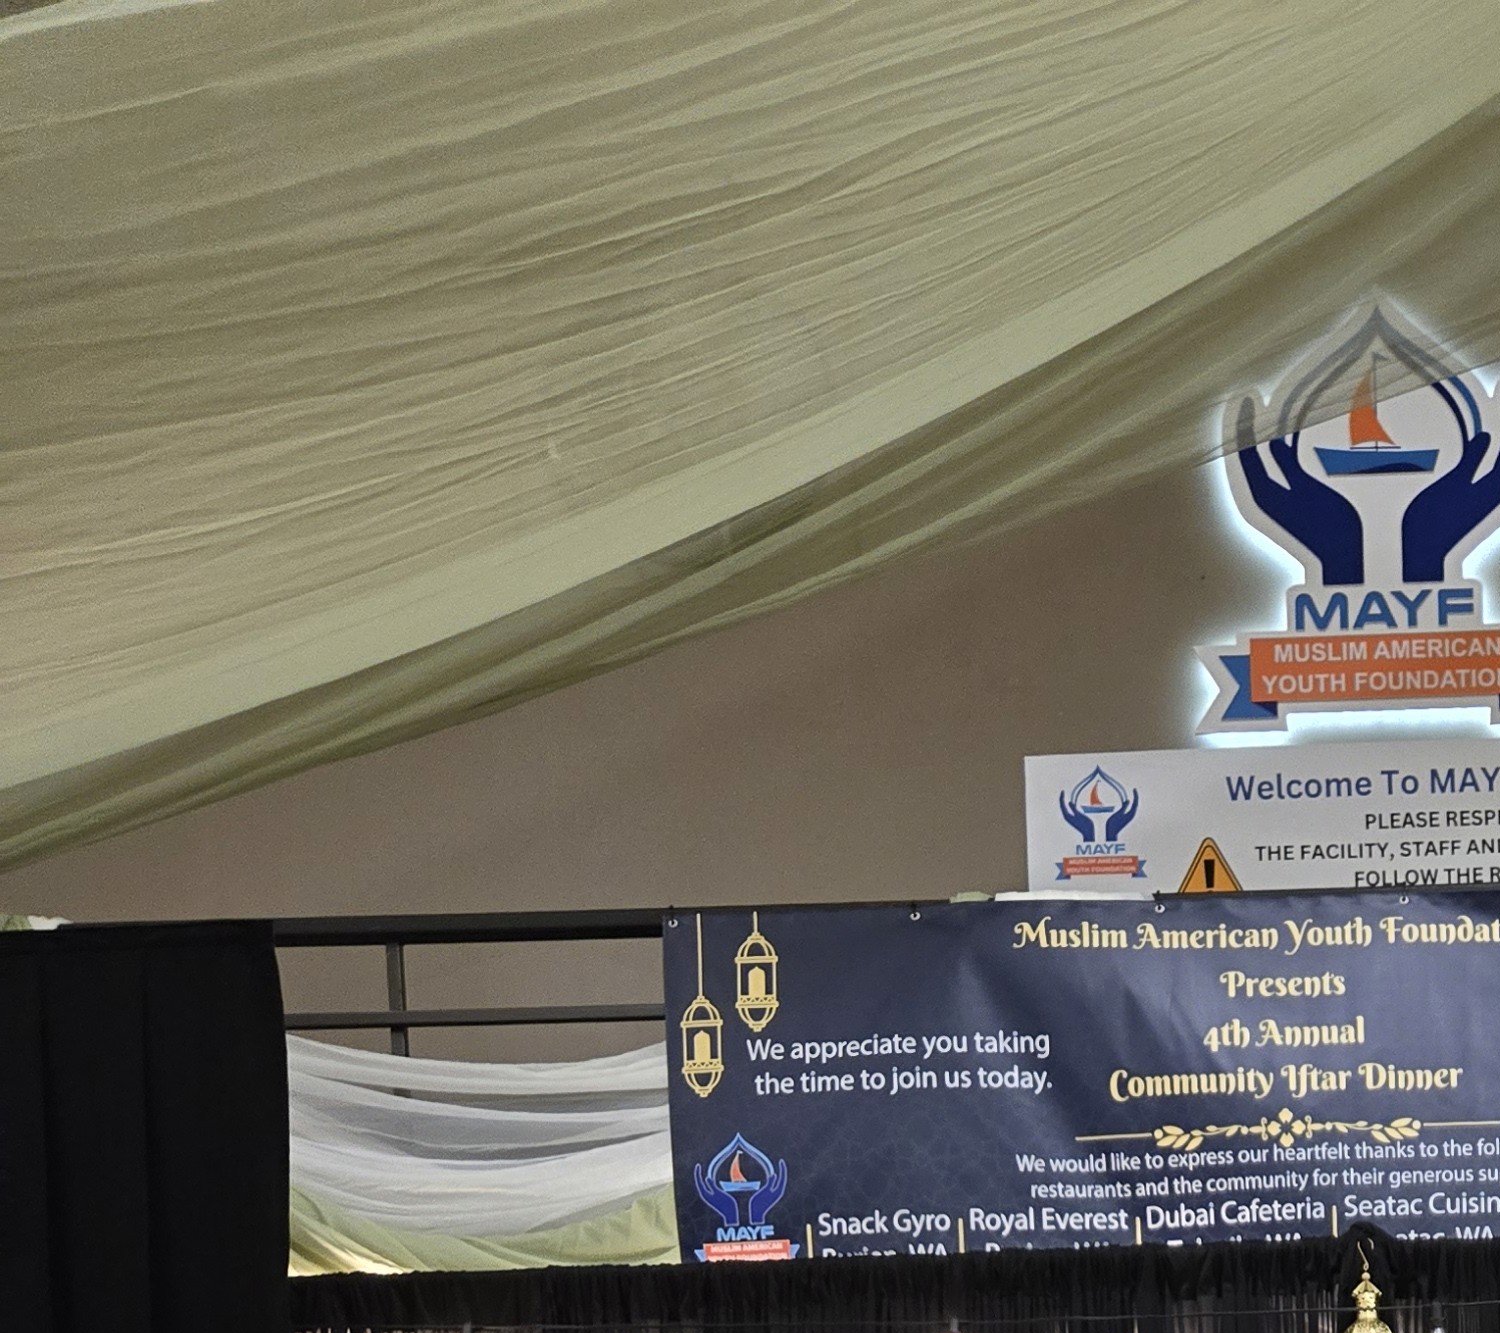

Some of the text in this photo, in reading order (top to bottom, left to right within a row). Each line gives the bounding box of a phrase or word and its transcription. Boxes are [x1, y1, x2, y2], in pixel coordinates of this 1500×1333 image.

[1295, 588, 1473, 631] MAYF
[1274, 637, 1500, 664] MUSLIM AMERICAN
[1262, 674, 1346, 695] YOUTH
[1226, 773, 1372, 800] Welcome
[1381, 770, 1418, 797] To
[1365, 811, 1440, 830] PLEASE
[1076, 843, 1126, 856] MAYF
[1255, 845, 1294, 861] THE
[1301, 841, 1395, 861] FACILITY,
[1400, 838, 1460, 857] STAFF
[1355, 868, 1438, 888] FOLLOW
[1444, 866, 1483, 884] THE
[1012, 916, 1128, 949] Muslim
[1132, 922, 1279, 950] American
[1284, 916, 1372, 955] Youth
[1219, 970, 1346, 998] Presents
[746, 1030, 1050, 1064] We appreciate you taking
[1203, 1016, 1365, 1052] 4th Annual
[754, 1063, 1053, 1096] the time to join us today.
[1109, 1061, 1464, 1102] Community Iftar Dinner
[1015, 1154, 1045, 1172] We
[1049, 1152, 1106, 1173] would
[1110, 1152, 1140, 1171] like
[1144, 1152, 1164, 1169] to
[1167, 1146, 1234, 1170] express
[1237, 1148, 1269, 1163] our
[1273, 1142, 1350, 1162] heartfelt
[1354, 1140, 1415, 1159] thanks
[1418, 1141, 1438, 1158] to
[1442, 1139, 1473, 1157] the
[1030, 1181, 1131, 1198] restaurants
[1135, 1176, 1169, 1196] and
[1172, 1175, 1202, 1194] the
[1206, 1171, 1308, 1192] community
[1312, 1170, 1338, 1186] for
[1341, 1168, 1385, 1185] their
[1388, 1168, 1474, 1189] generous
[1146, 1196, 1326, 1230] Dubai Cafeteria
[1344, 1193, 1423, 1218] Seatac
[716, 1225, 775, 1242] MAYF
[818, 1210, 951, 1238] Snack Gyro
[969, 1207, 1129, 1236] Royal Everest
